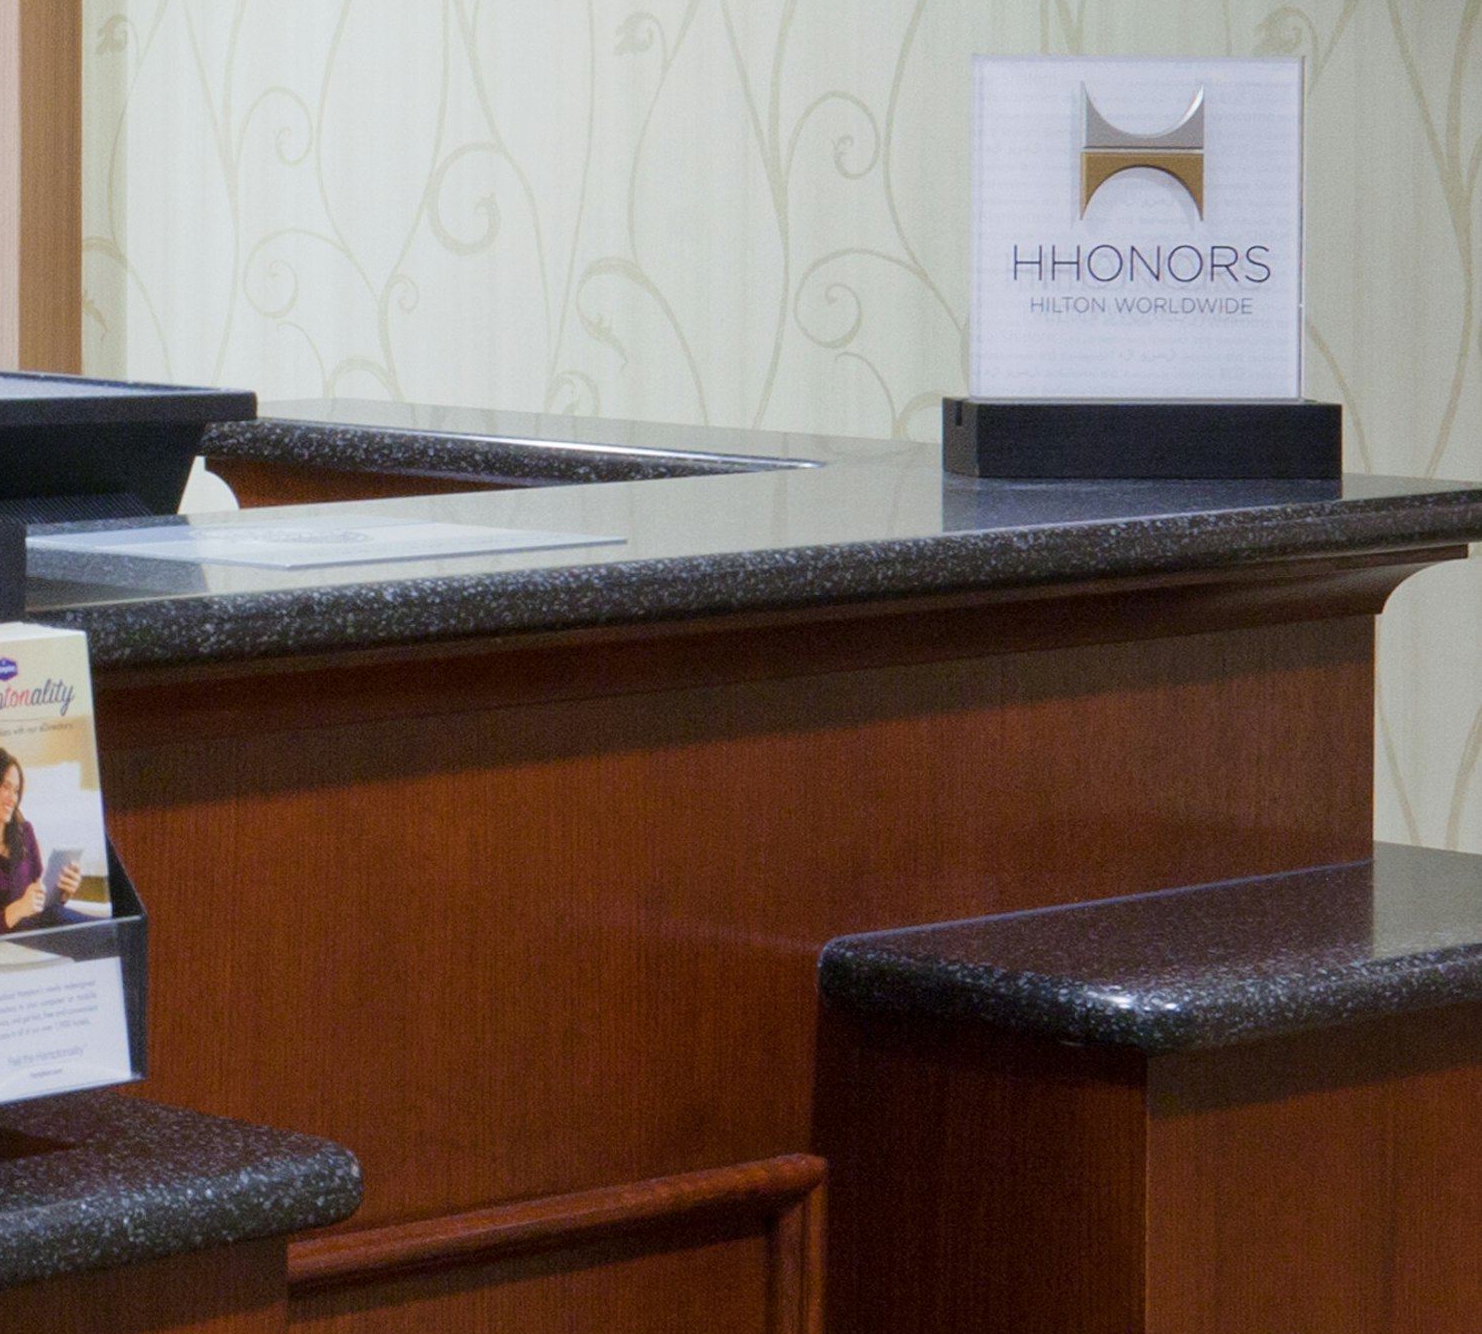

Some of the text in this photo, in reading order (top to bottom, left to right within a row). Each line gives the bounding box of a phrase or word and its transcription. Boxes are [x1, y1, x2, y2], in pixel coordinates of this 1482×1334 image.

[1011, 244, 1272, 284] HHONORS
[1029, 296, 1255, 316] HILTON WORLDWIDE
